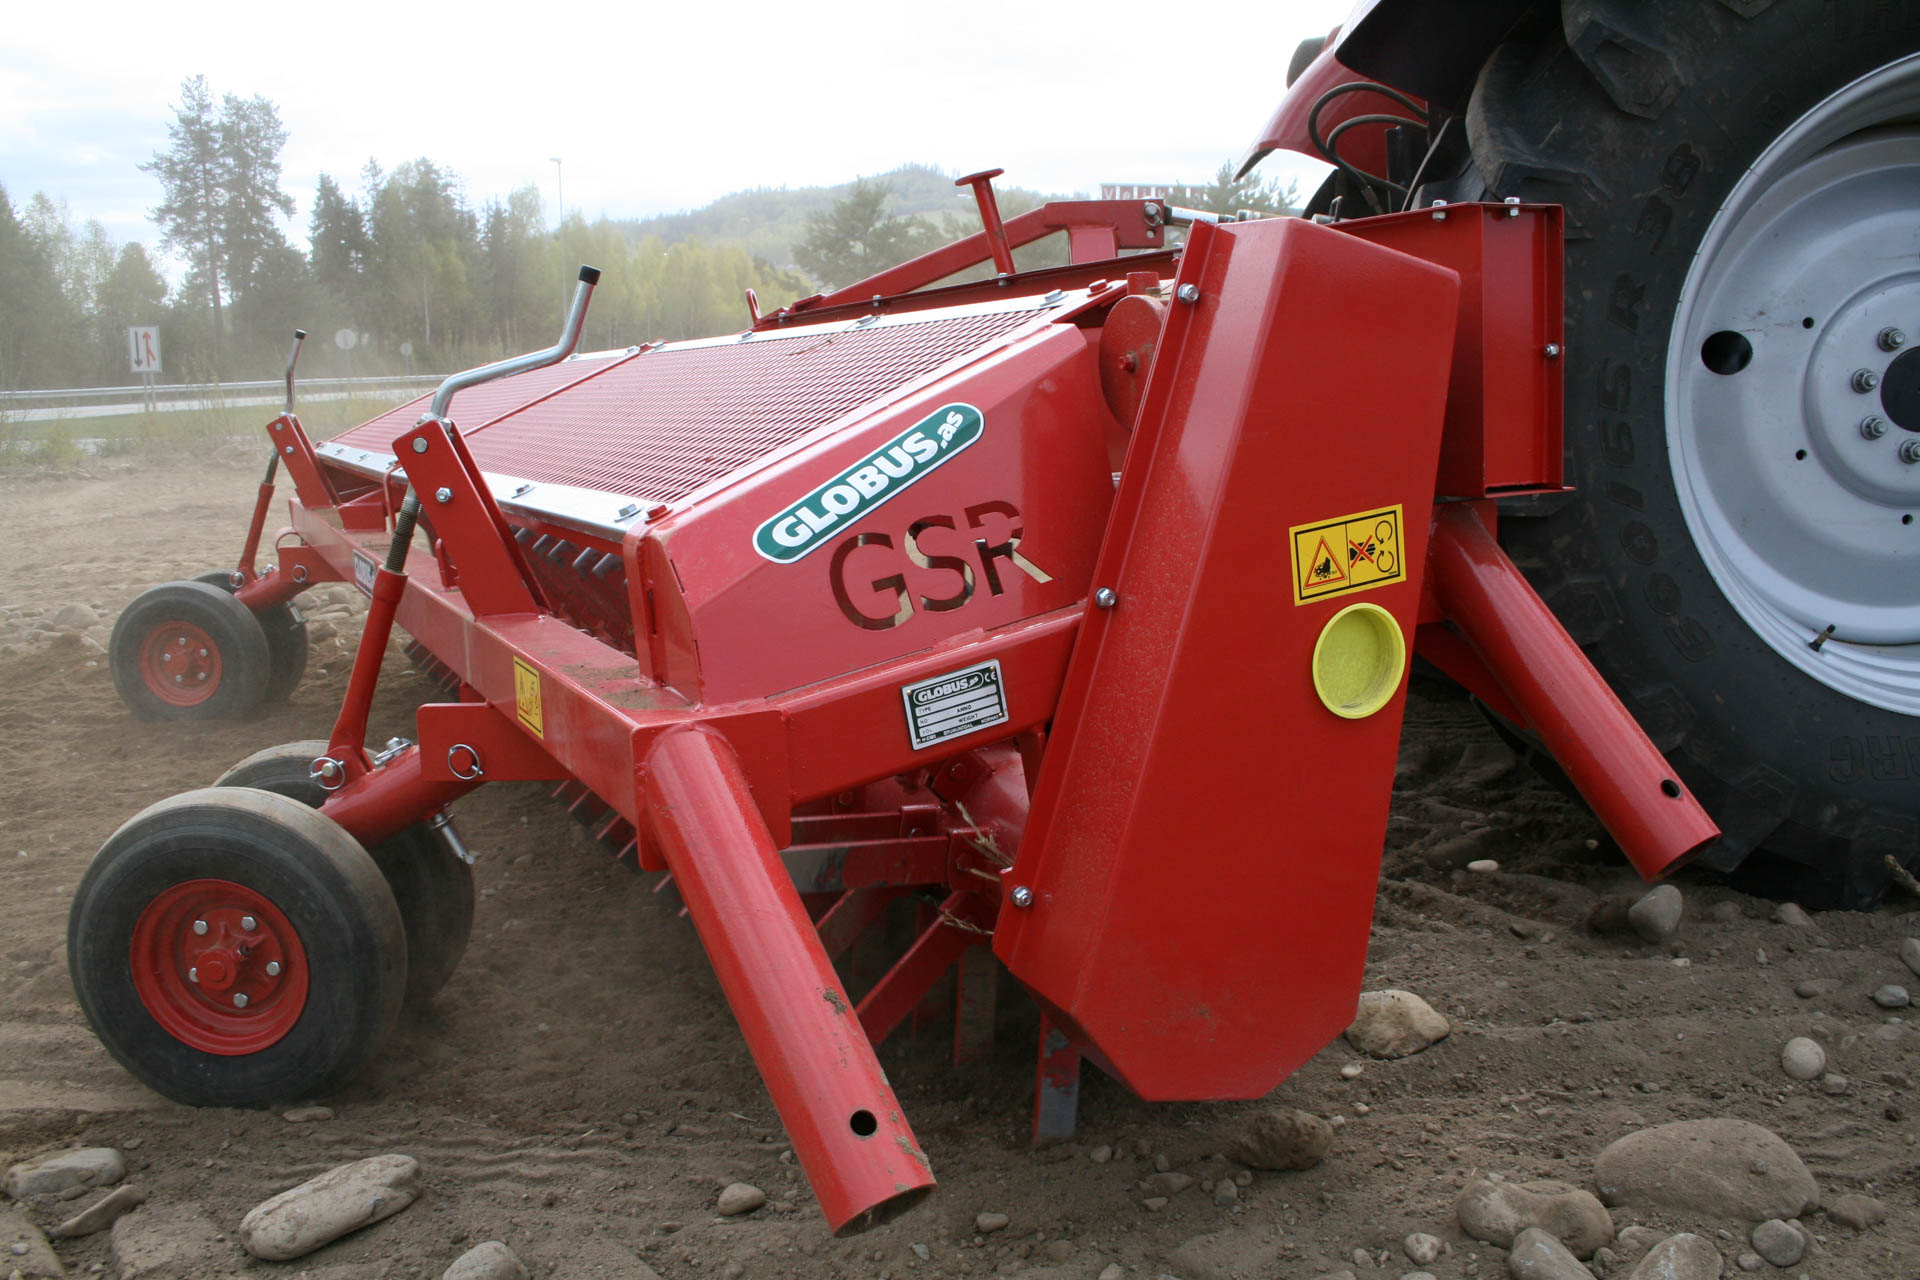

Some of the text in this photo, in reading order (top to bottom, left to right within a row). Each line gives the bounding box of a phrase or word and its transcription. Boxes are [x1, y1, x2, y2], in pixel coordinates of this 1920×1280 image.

[829, 500, 1054, 631] GSR
[918, 706, 931, 714] TYPE
[956, 704, 972, 713] ANNO
[958, 712, 978, 723] WEIGHT
